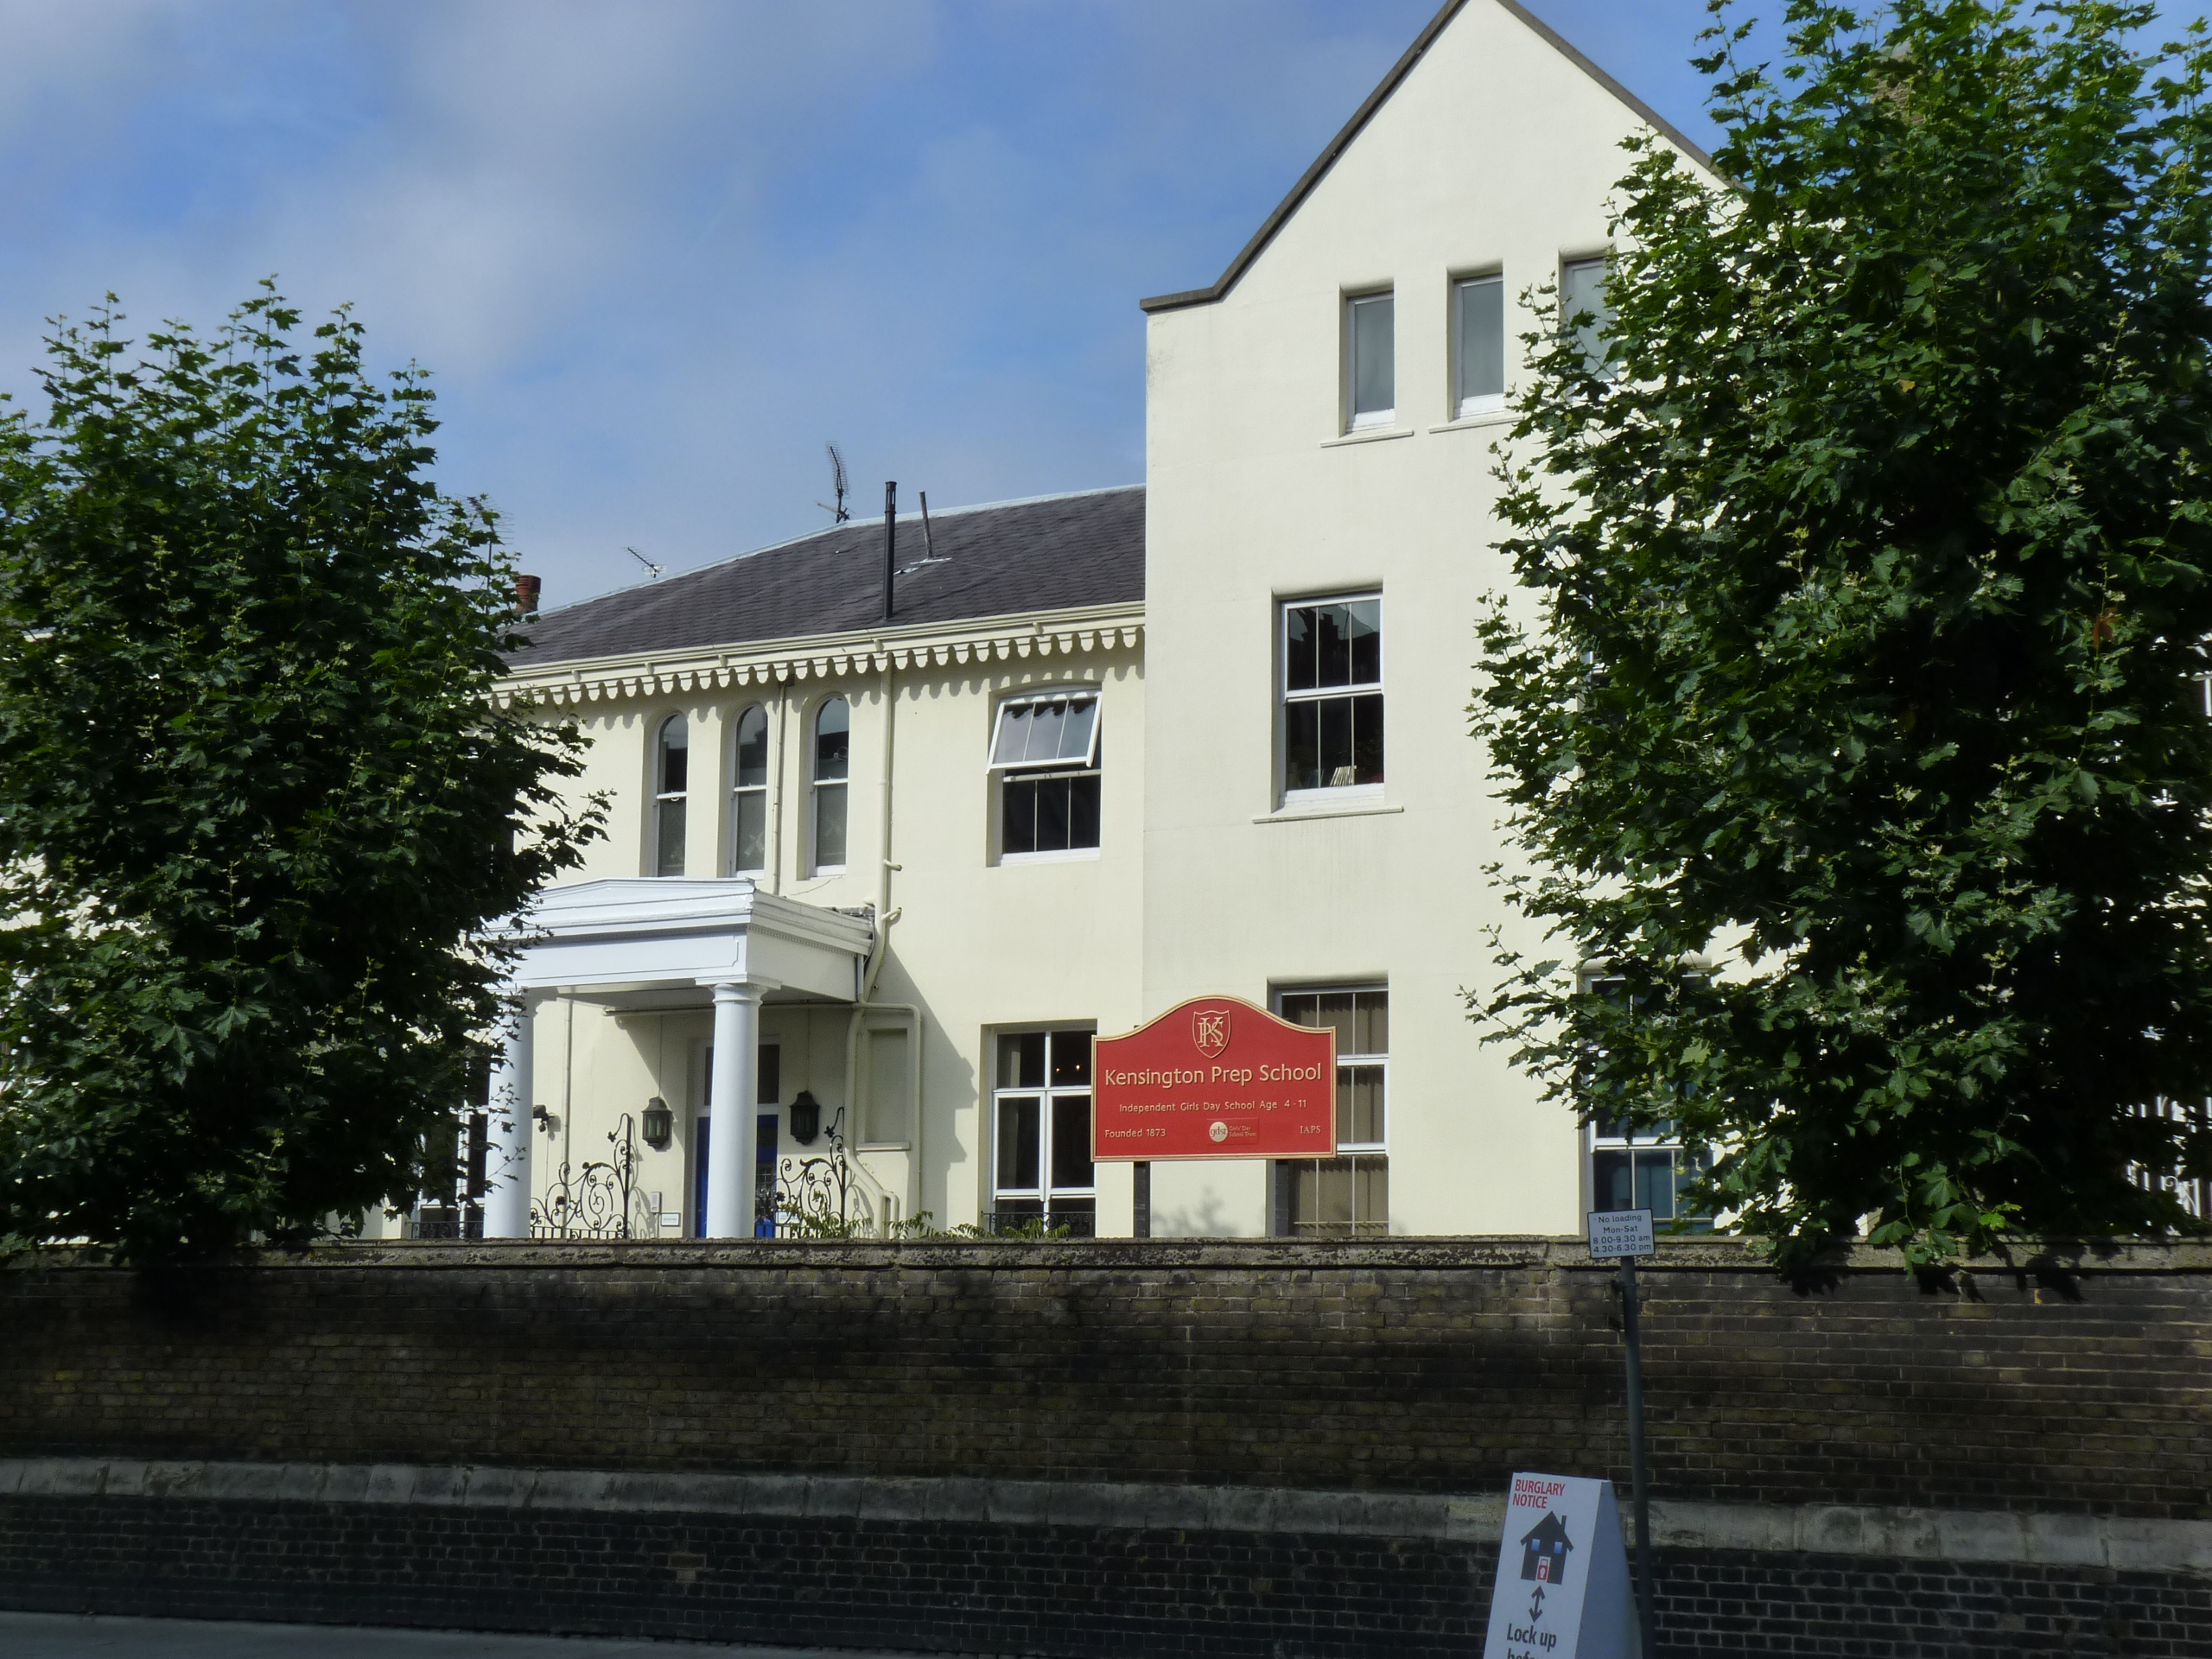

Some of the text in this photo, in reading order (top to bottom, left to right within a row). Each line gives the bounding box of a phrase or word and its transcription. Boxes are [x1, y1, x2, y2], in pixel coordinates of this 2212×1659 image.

[1105, 1063, 1321, 1089] Kensington Prep School
[1119, 1103, 1176, 1114] Independent
[1180, 1103, 1199, 1111] Girls
[1203, 1102, 1221, 1112] Day
[1224, 1101, 1255, 1110] School
[1259, 1100, 1278, 1111] Age
[1284, 1100, 1291, 1109] 4
[1298, 1099, 1307, 1109] 11
[1105, 1128, 1166, 1138] Founded 1873
[1211, 1126, 1227, 1138] gdst
[1300, 1125, 1321, 1134] IAPS
[1612, 1214, 1642, 1223] loading
[1603, 1225, 1638, 1234] Mon-Sat
[1593, 1235, 1636, 1244] 8.00-9.30
[1593, 1243, 1636, 1253] 4.30-6.30
[1515, 1478, 1566, 1496] BURGLARY
[1512, 1493, 1548, 1509] NOTICE
[1507, 1623, 1557, 1652] Lock up
